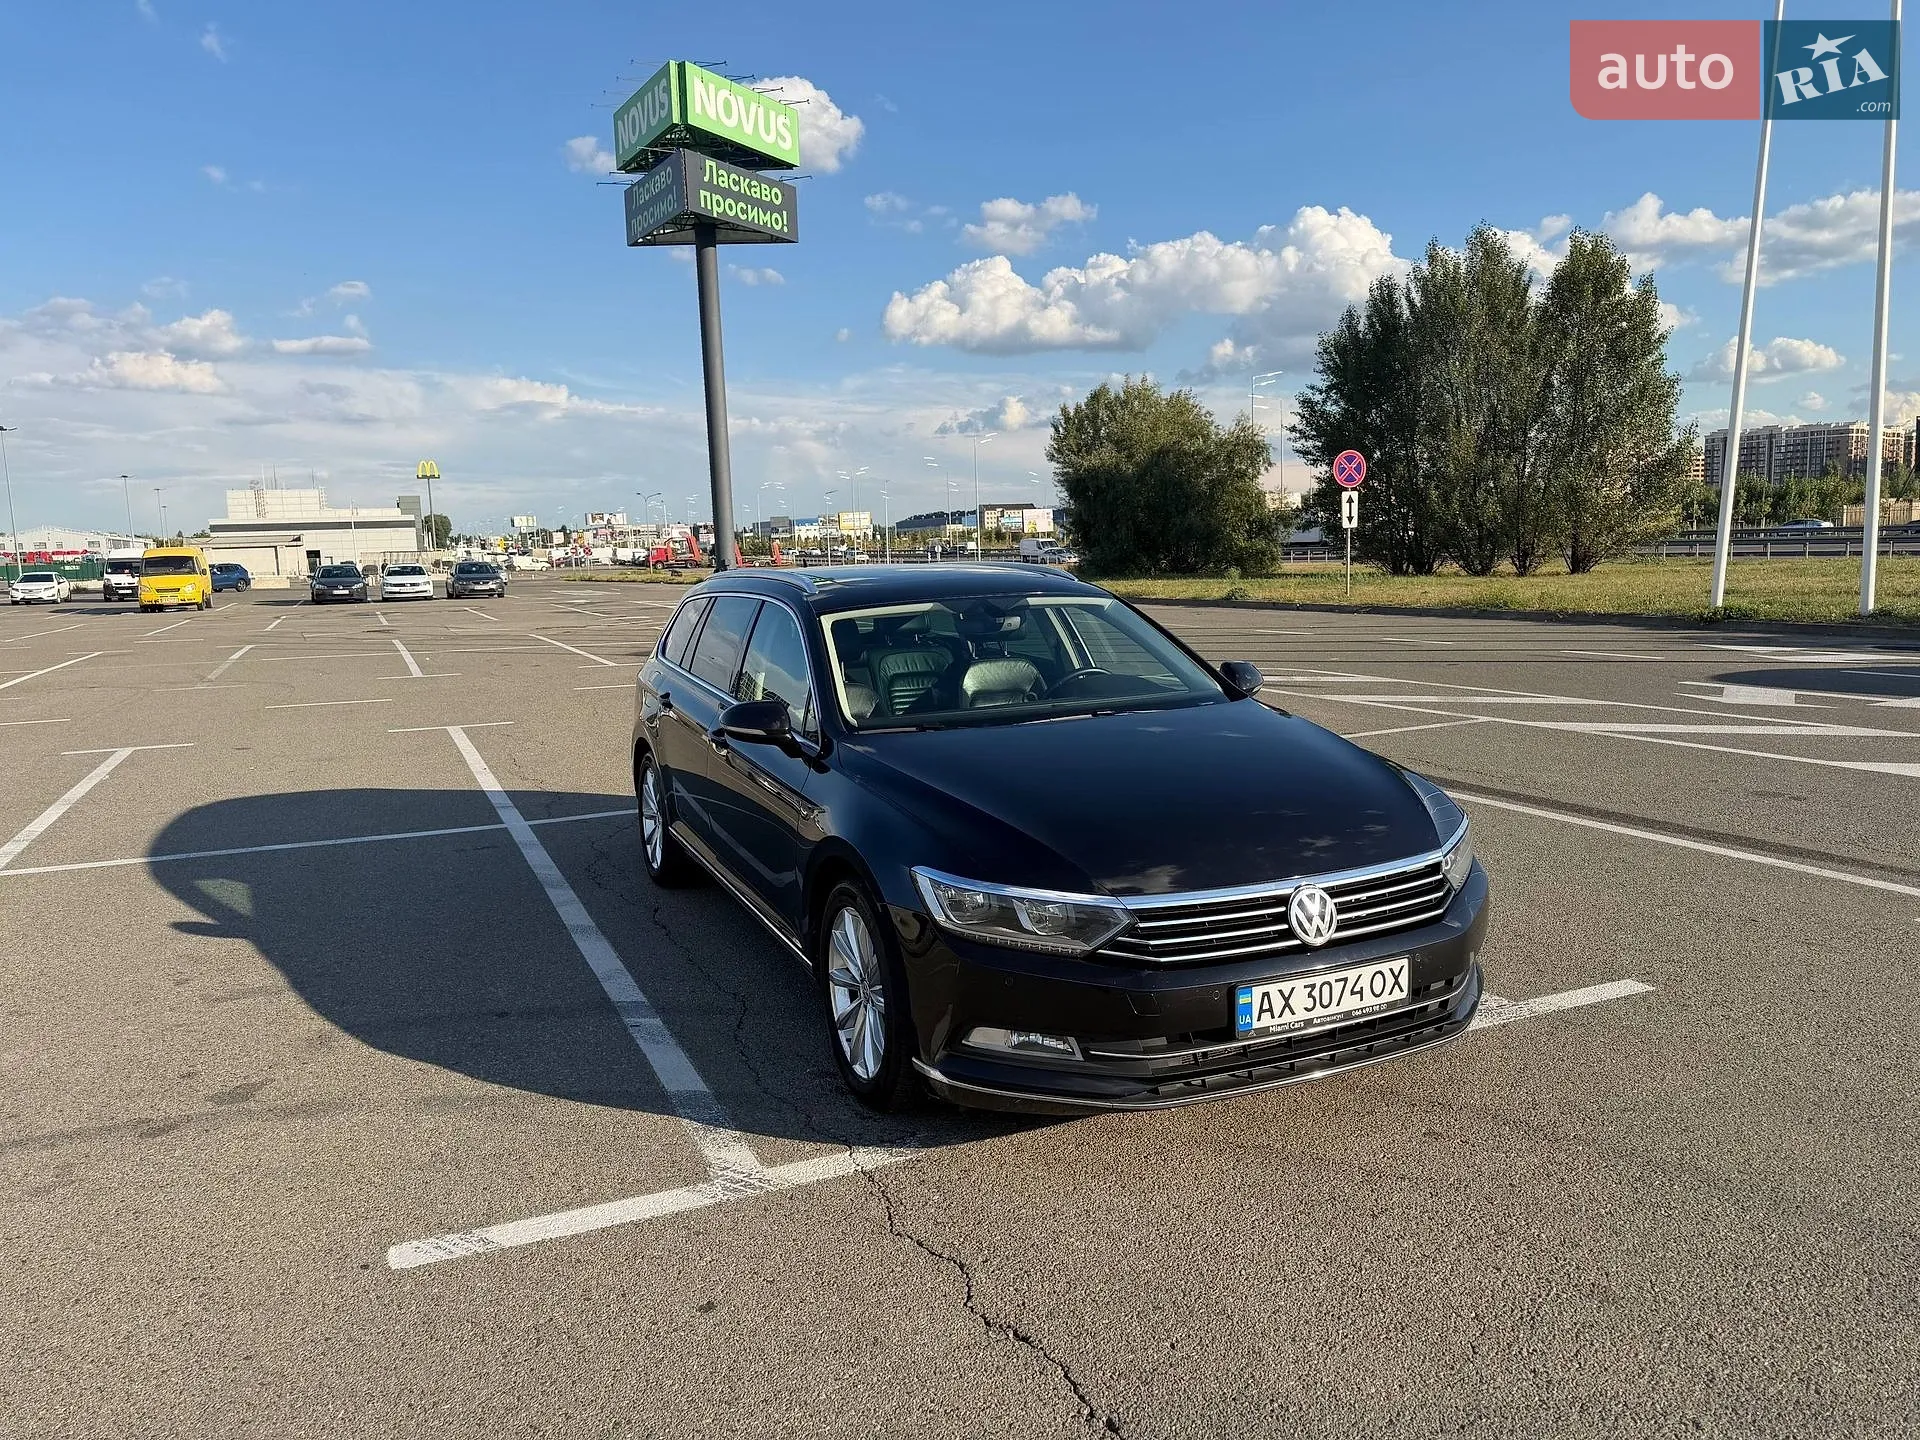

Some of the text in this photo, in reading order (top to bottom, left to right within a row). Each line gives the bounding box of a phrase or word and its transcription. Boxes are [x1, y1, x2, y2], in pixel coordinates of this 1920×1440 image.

[617, 78, 669, 154] NOVUS
[694, 76, 793, 150] NOVUS
[632, 166, 673, 209] Ласкаво
[704, 159, 782, 206] Ласкаво
[631, 186, 677, 238] просимо!
[700, 189, 789, 233] просимо!
[1257, 964, 1405, 1022] AX 3074 OX
[1239, 1014, 1252, 1025] UA
[1290, 1021, 1305, 1030] Cars
